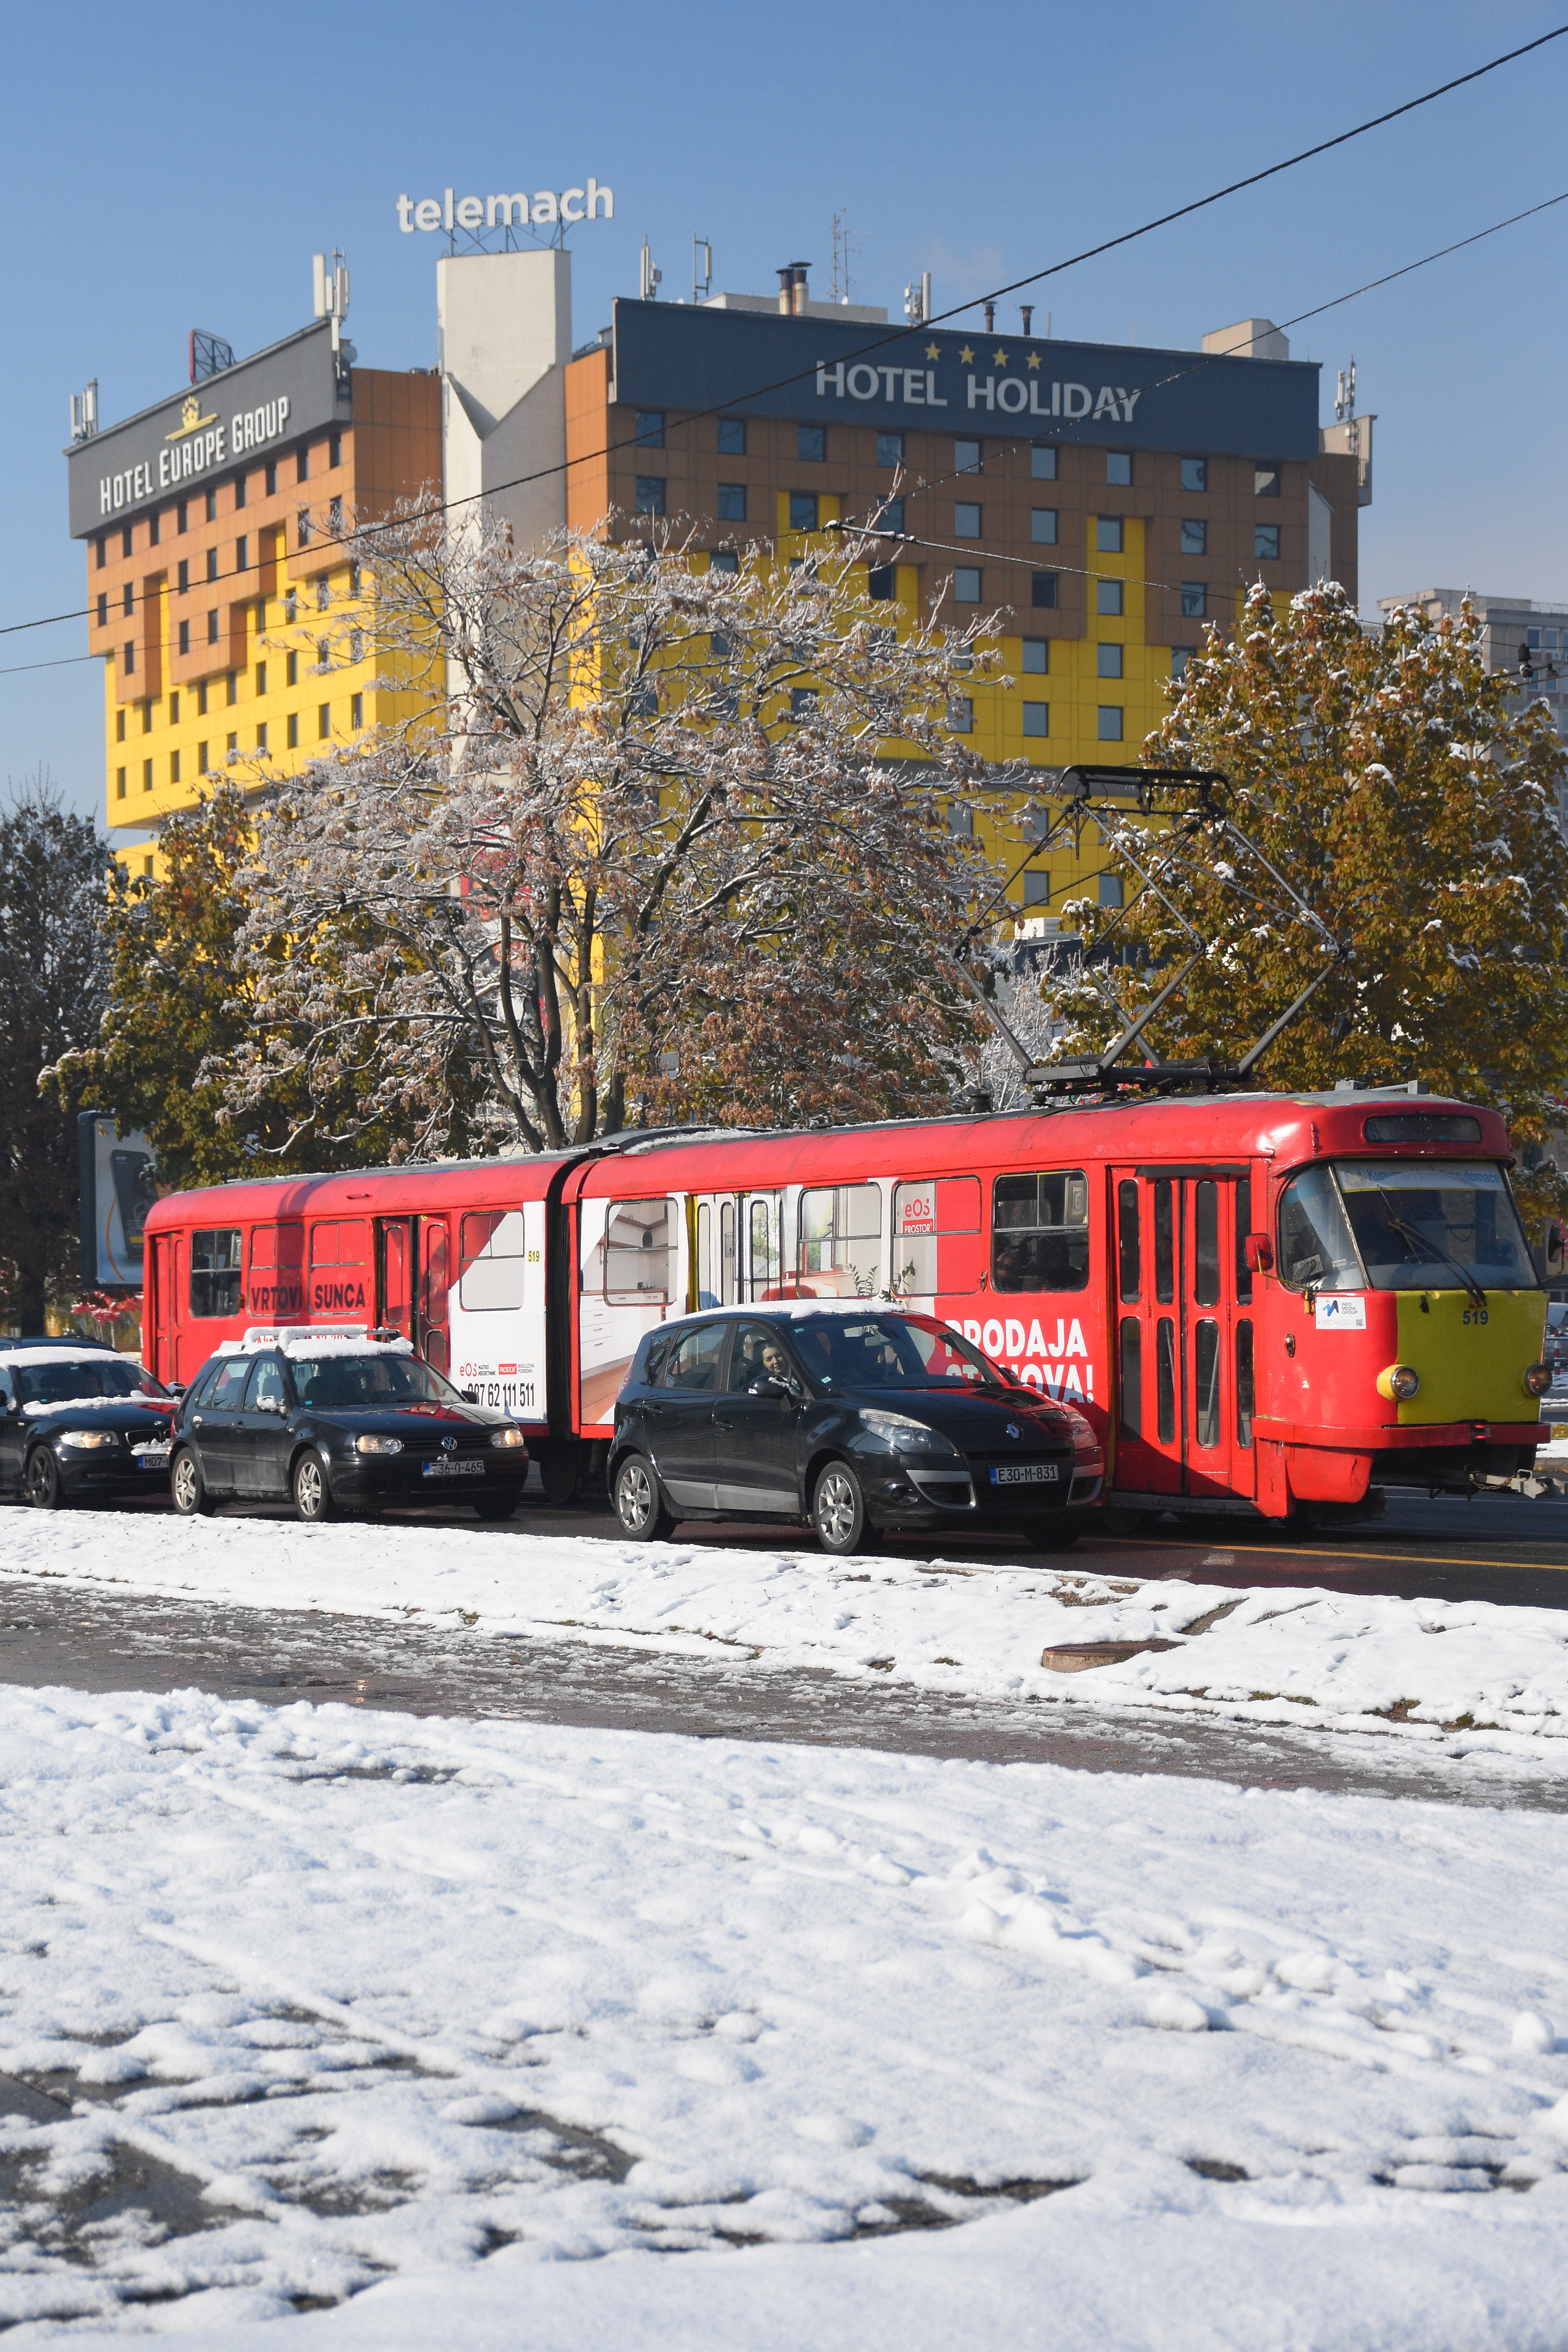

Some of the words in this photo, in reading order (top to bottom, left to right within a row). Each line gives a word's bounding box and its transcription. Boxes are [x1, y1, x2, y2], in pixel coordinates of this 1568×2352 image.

[397, 178, 614, 233] telemach
[816, 360, 947, 406] HOTEL
[967, 374, 1141, 422] HOLIDAY
[100, 462, 153, 514] HOTEL
[159, 425, 225, 488] EUROPE
[232, 396, 289, 453] GROUP
[904, 1224, 930, 1234] PROSTOR
[529, 1251, 539, 1262] 519
[252, 1285, 302, 1311] VRTOVI
[315, 1283, 365, 1309] SUNCA
[1463, 1310, 1488, 1325] 519
[488, 1383, 500, 1407] 62
[503, 1383, 516, 1407] 111
[520, 1383, 534, 1406] 511
[998, 1466, 1056, 1482] E30-M-831
